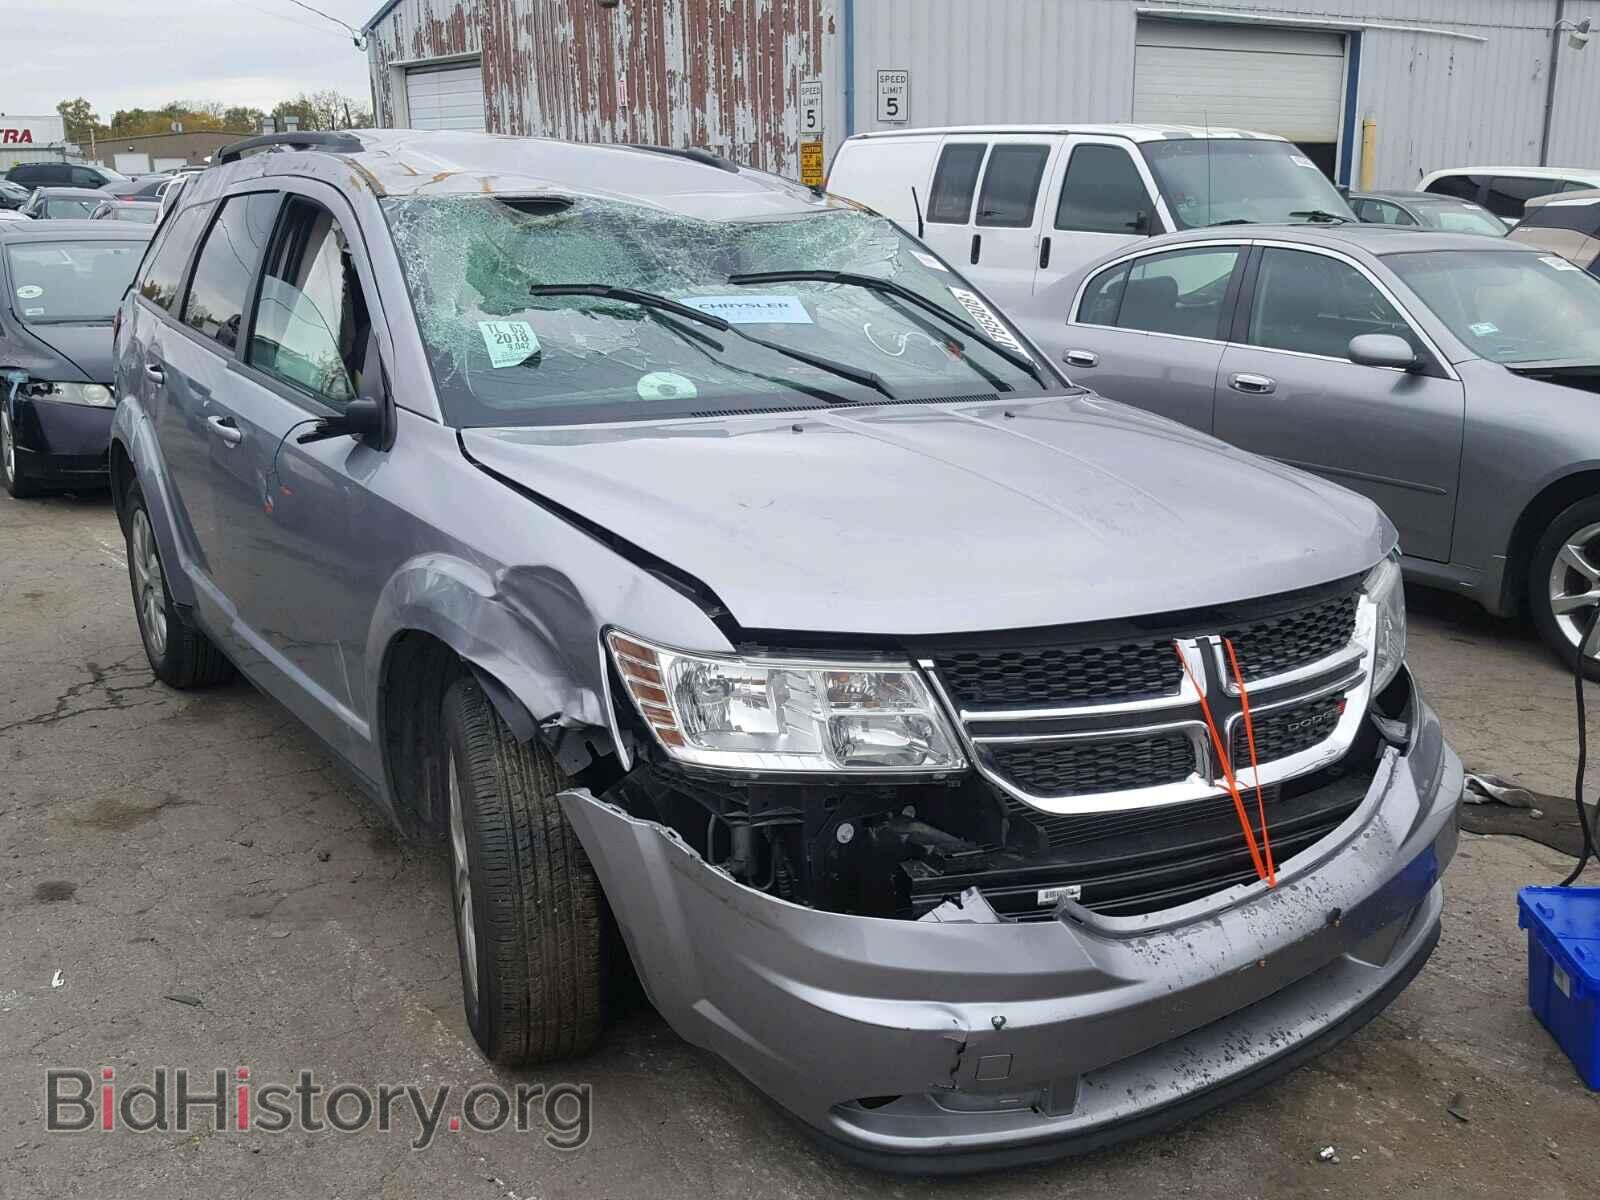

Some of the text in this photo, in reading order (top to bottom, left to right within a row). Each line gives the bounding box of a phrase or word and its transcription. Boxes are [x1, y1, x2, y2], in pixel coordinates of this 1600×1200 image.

[880, 75, 906, 83] SPEED
[801, 87, 820, 96] SPEED
[882, 86, 903, 95] LIMIT
[803, 98, 819, 107] LIMIT
[886, 97, 899, 116] 5
[806, 109, 816, 128] 5
[698, 302, 790, 310] CHRYSLER
[494, 332, 529, 345] 2018
